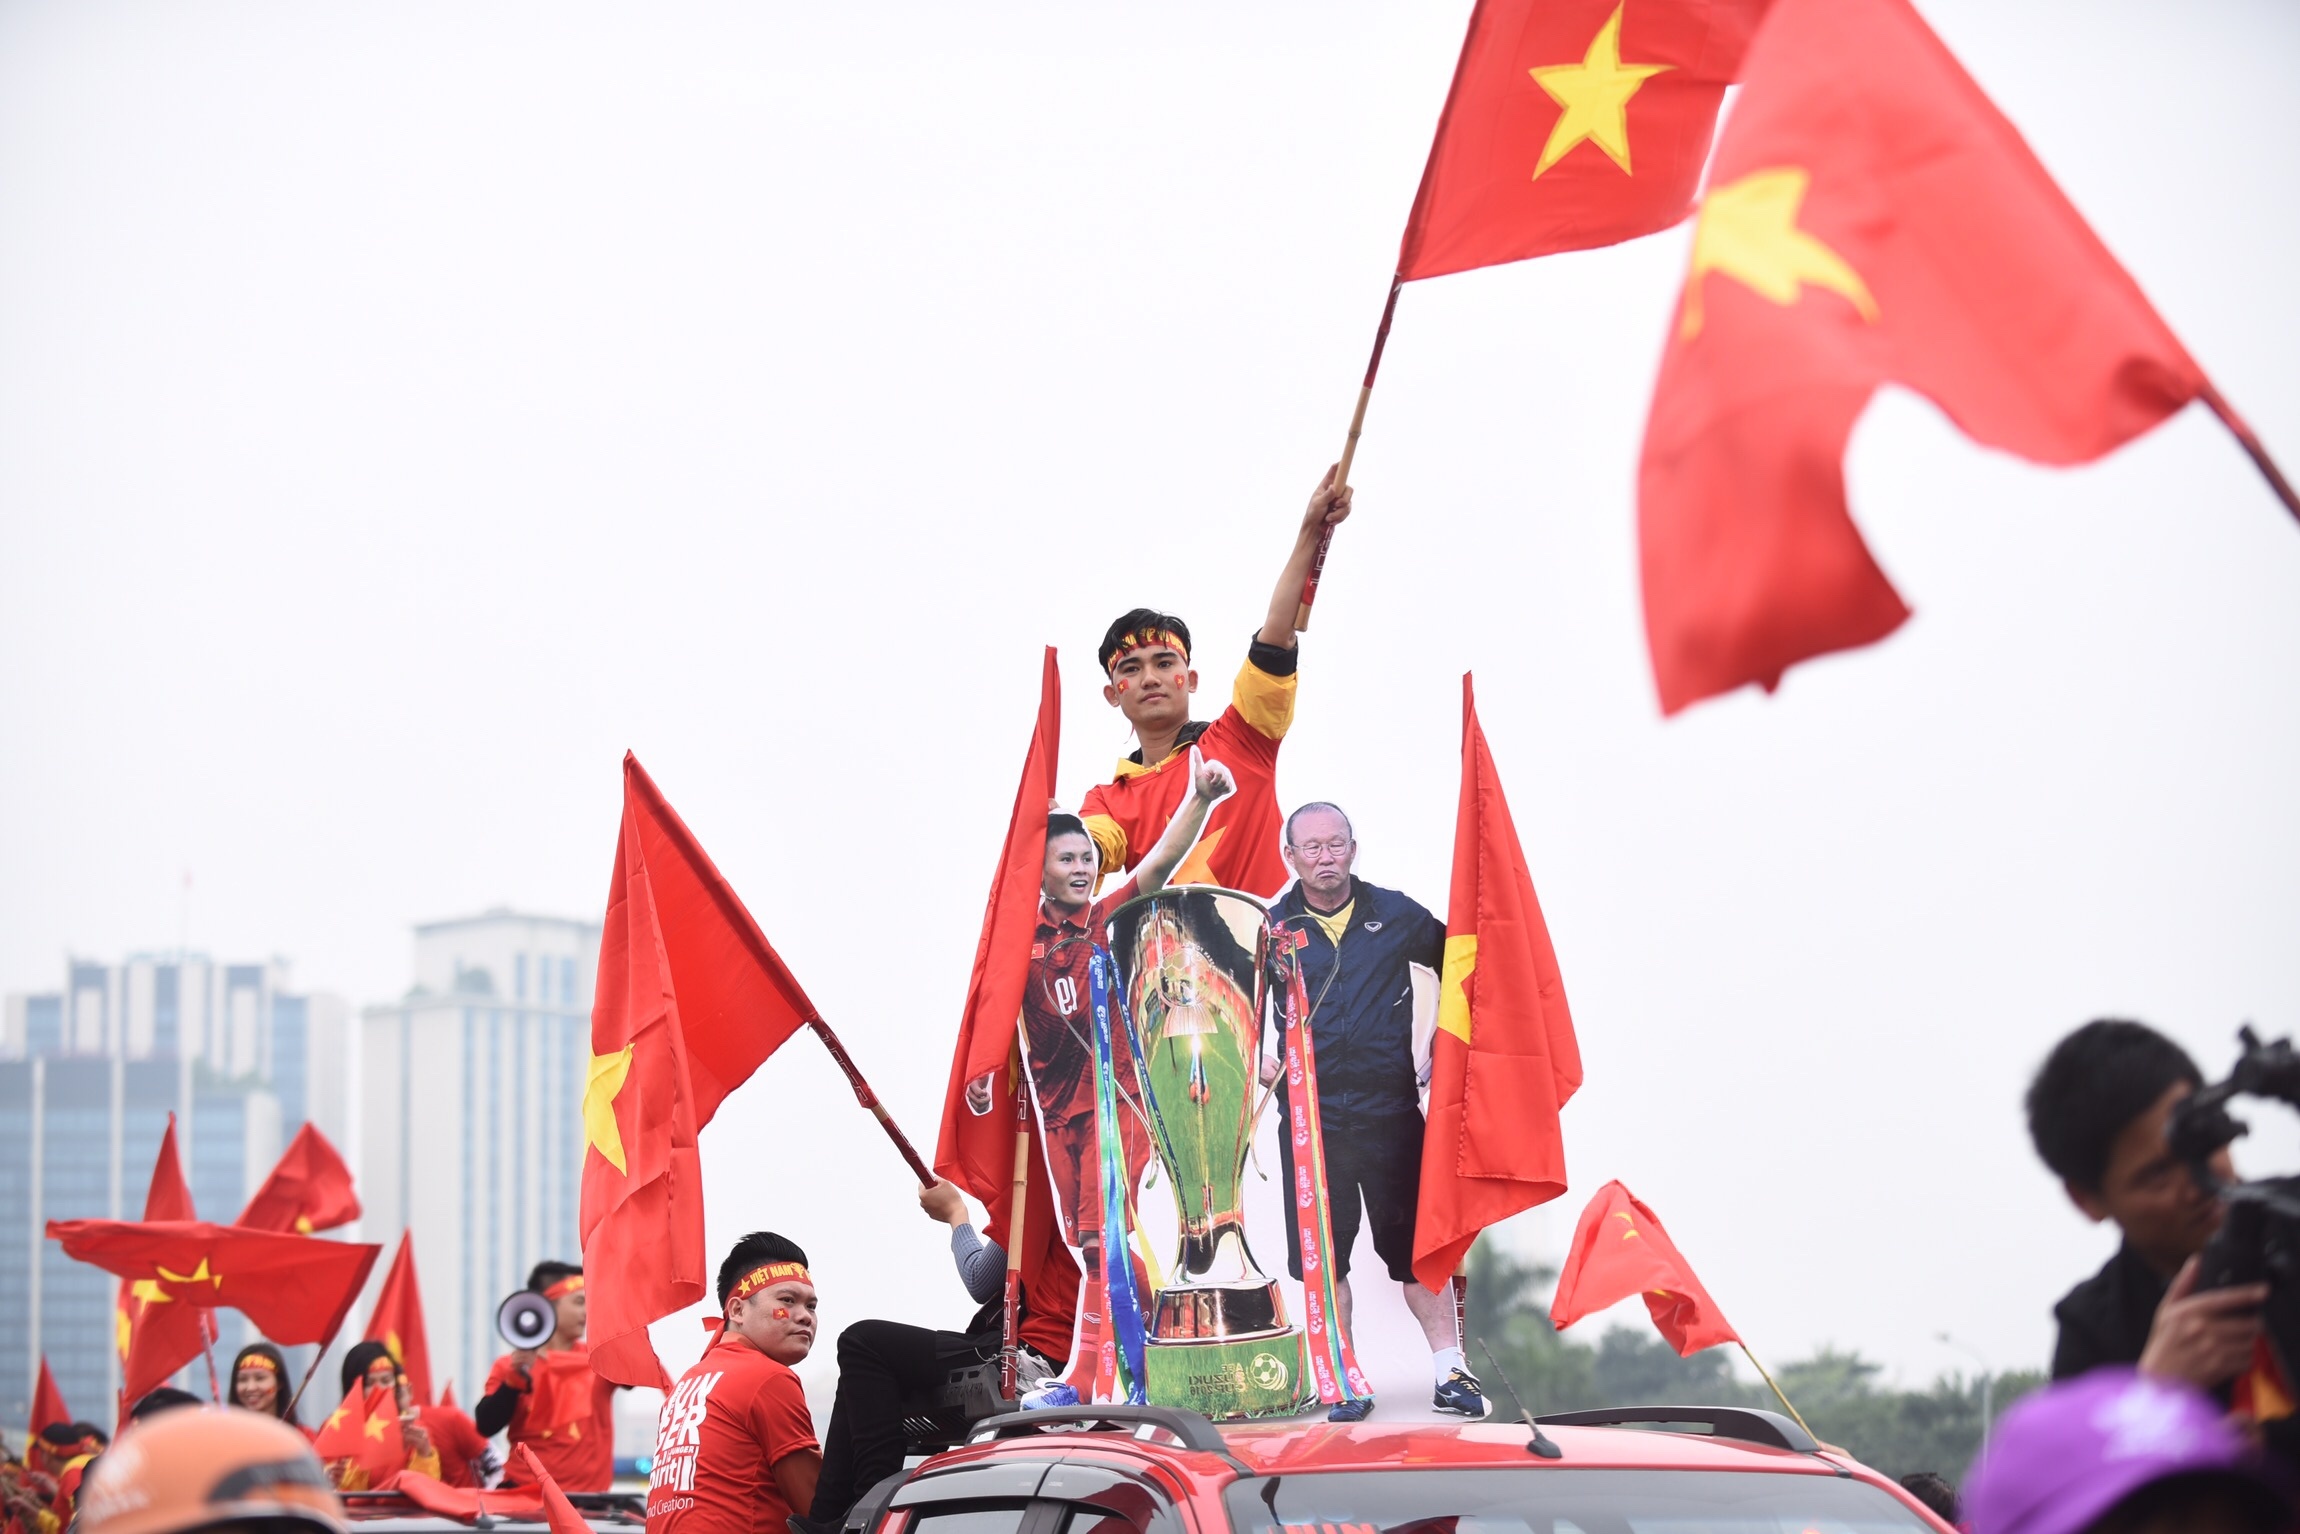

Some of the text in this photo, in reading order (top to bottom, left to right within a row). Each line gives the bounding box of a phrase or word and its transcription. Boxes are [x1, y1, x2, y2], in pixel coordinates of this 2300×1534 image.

[750, 1268, 770, 1286] VIỆT
[769, 1264, 794, 1278] NAM
[657, 1495, 694, 1515] Creation
